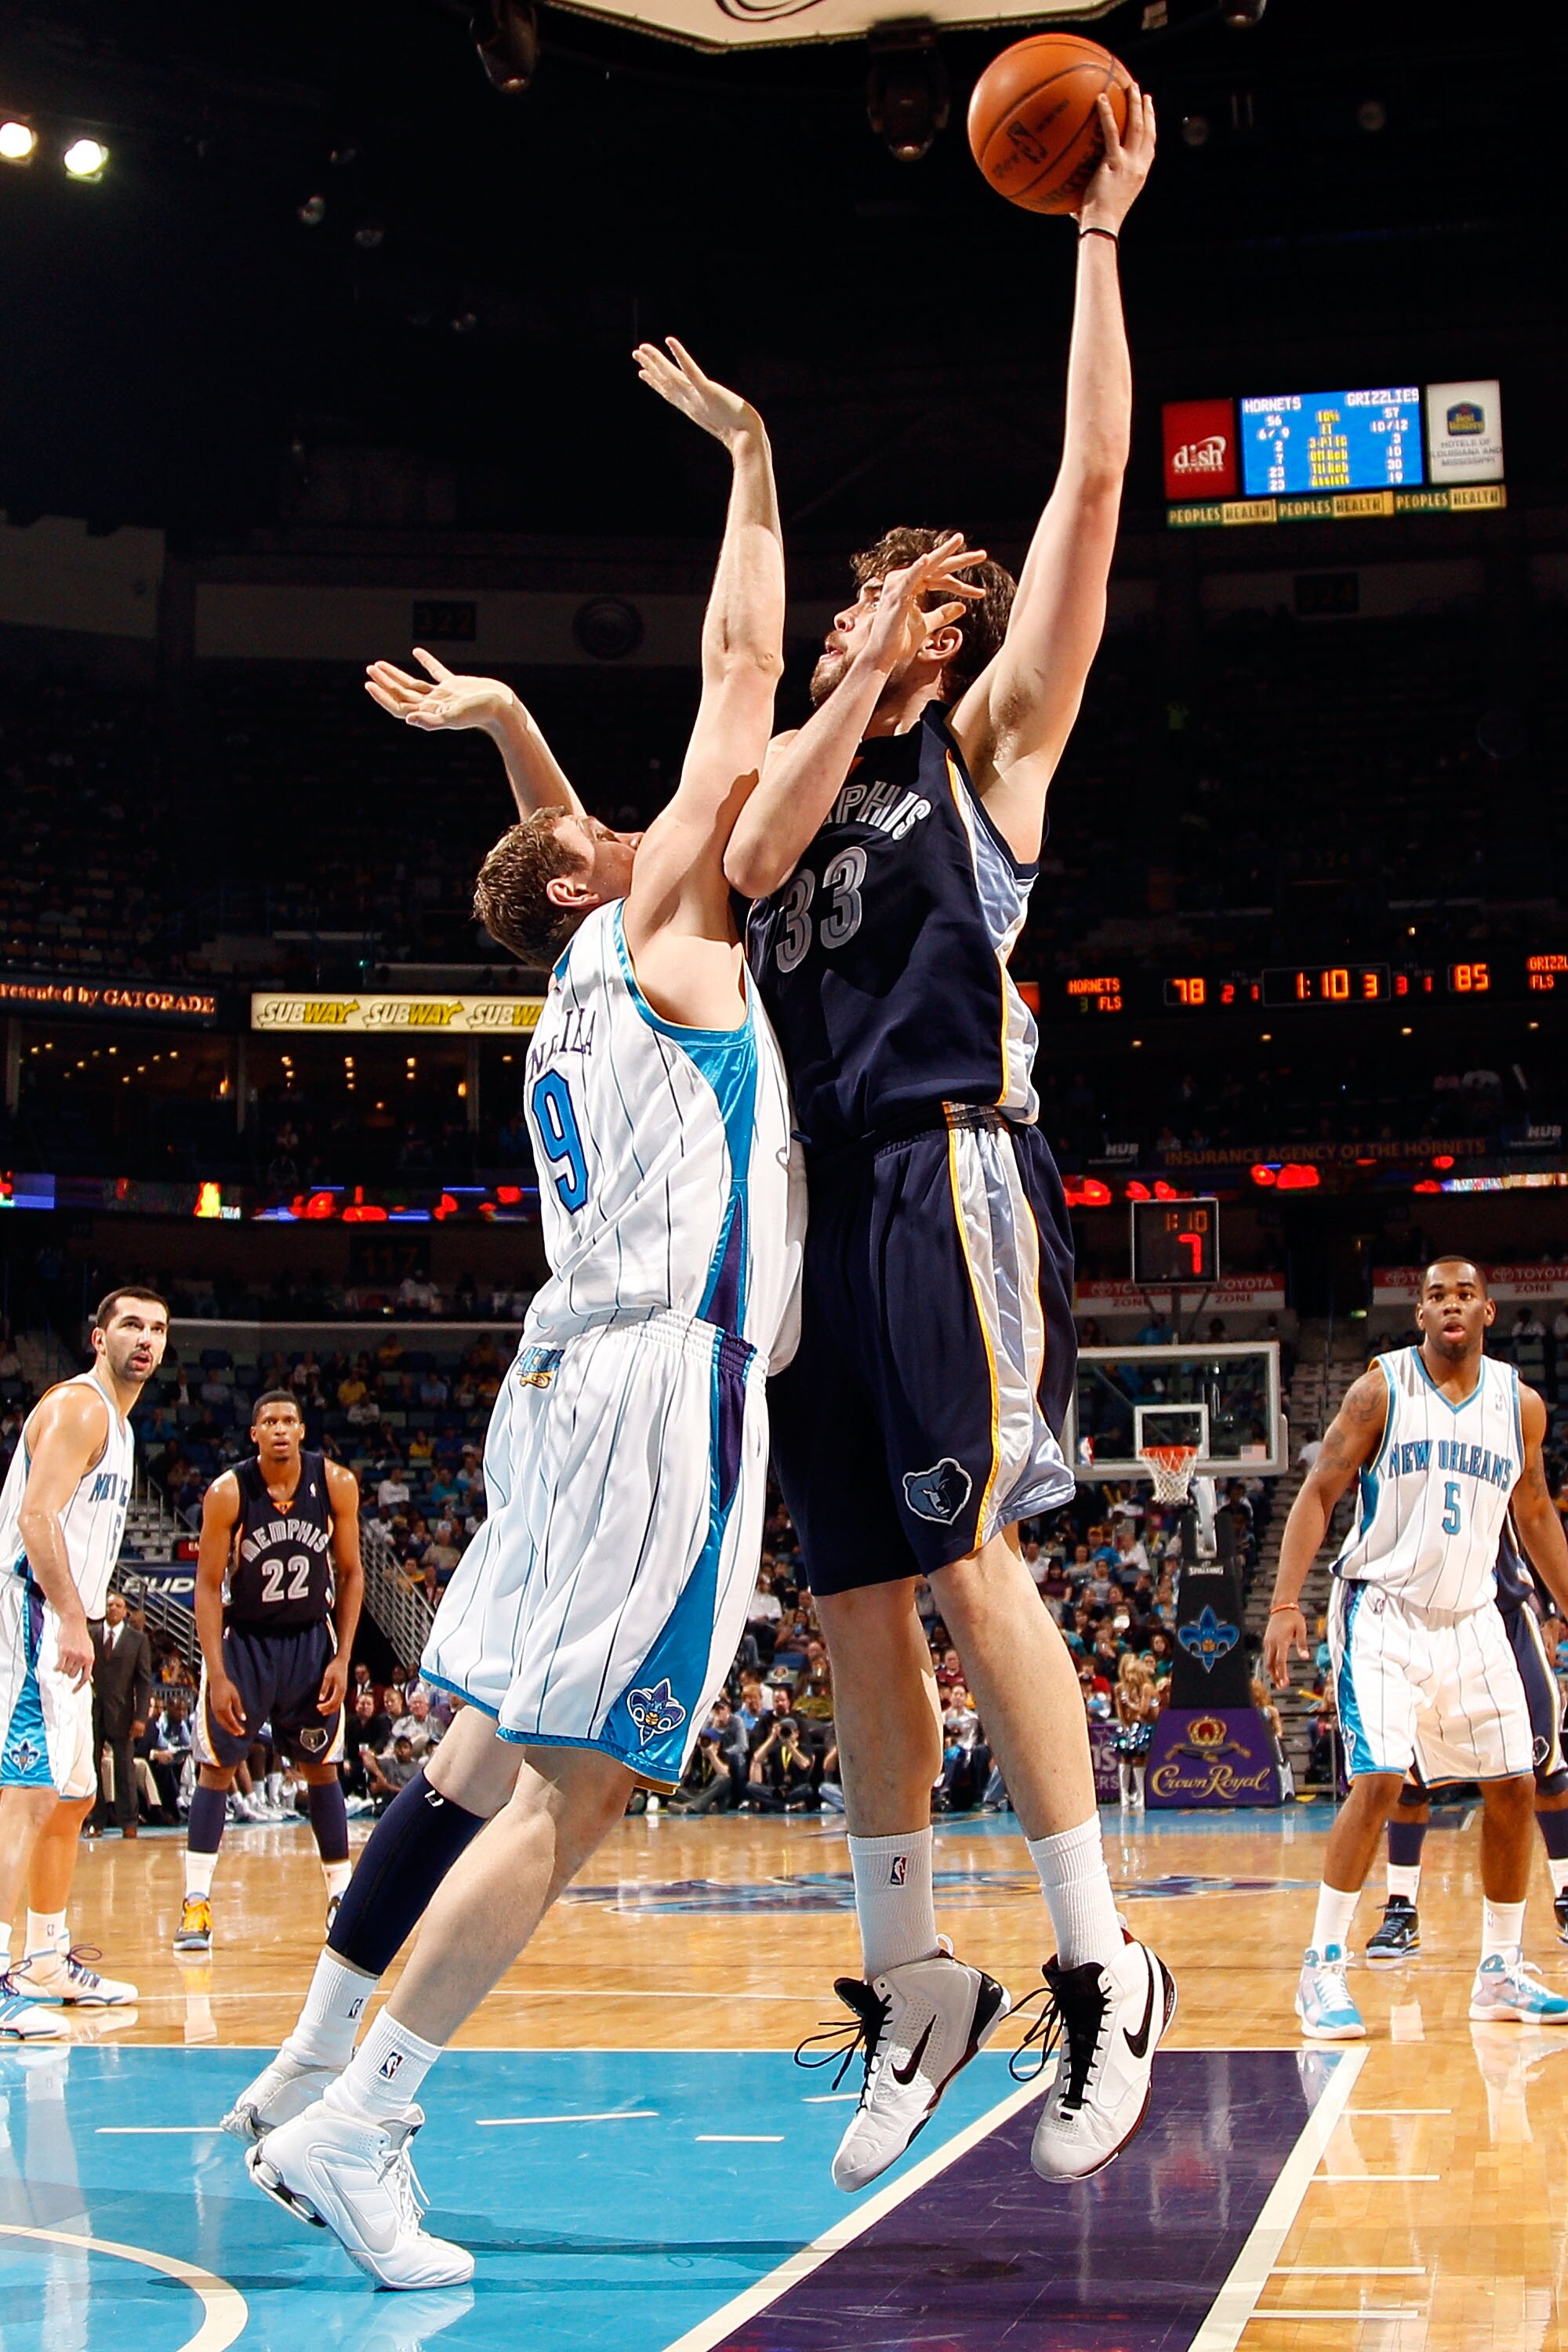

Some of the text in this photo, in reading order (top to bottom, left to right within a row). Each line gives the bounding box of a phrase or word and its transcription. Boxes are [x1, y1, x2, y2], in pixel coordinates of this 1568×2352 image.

[1244, 397, 1301, 413] HORNETS
[1346, 388, 1419, 406] GRIZZLIES
[1266, 415, 1282, 426] 56
[1384, 406, 1399, 419] 57
[1371, 419, 1408, 432] 10/12
[1276, 440, 1283, 452] 2
[1393, 433, 1401, 444] 3
[1173, 437, 1225, 469] dish
[1276, 452, 1284, 464] 7
[1388, 445, 1402, 457] 10
[1269, 466, 1285, 477] 23
[1387, 458, 1403, 470] 30
[1269, 478, 1286, 492] 23
[1390, 471, 1403, 484] 19
[1169, 489, 1501, 524] PEOPLES HEALTH PEOPLES HEALTH PEOPLES HEALTH
[823, 781, 931, 840] PHIS
[776, 847, 867, 972] 33
[1069, 978, 1120, 995] HORNETS
[1298, 969, 1348, 1000] 1:10
[1363, 974, 1378, 1000] 3
[1396, 975, 1408, 996] 3
[1424, 976, 1432, 994] 1
[1454, 964, 1489, 992] 85
[1531, 975, 1554, 991] FLS
[78, 985, 99, 1007] by
[103, 989, 215, 1014] GATORADE
[1174, 978, 1204, 1004] 78
[1221, 984, 1235, 1004] 2
[1252, 984, 1260, 1002] 1
[1098, 996, 1122, 1011] FLS
[259, 999, 359, 1026] SUBWAY
[362, 1000, 465, 1027] SUBWAY
[1527, 1123, 1563, 1139] HUB
[532, 1068, 589, 1214] 9
[1105, 1142, 1140, 1156] HUB
[1165, 1138, 1487, 1167] INSURANCE AGENCY OF THE HORNETS
[1165, 1208, 1210, 1233] 1:10
[1178, 1231, 1203, 1276] 7
[1218, 1276, 1276, 1292] OYOTA
[1515, 1282, 1554, 1294] ZONE
[1215, 1293, 1252, 1305] ZONE
[1388, 1439, 1513, 1492] NEW ORLEANS
[1441, 1480, 1462, 1536] 5
[240, 1518, 330, 1563] MEMPHIS
[122, 1576, 196, 1595] BUD
[261, 1554, 310, 1603] 22
[1151, 1764, 1272, 1800] Crown Royal
